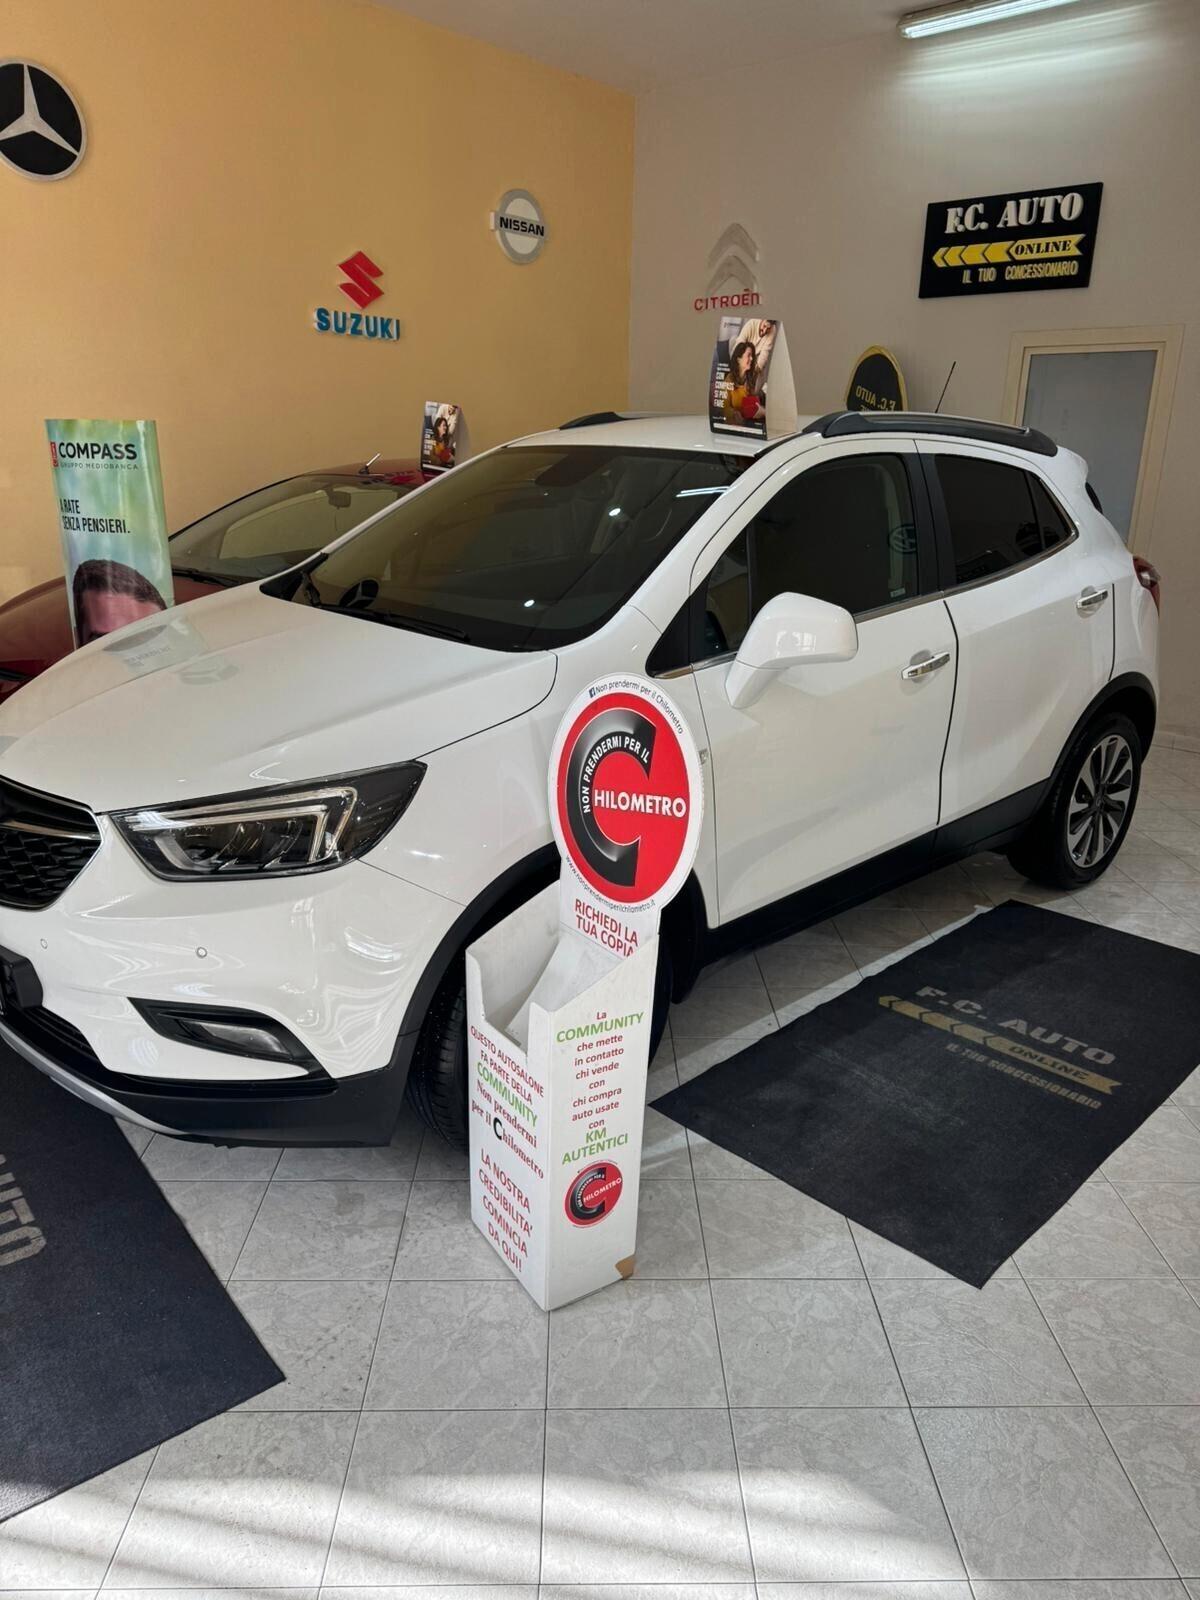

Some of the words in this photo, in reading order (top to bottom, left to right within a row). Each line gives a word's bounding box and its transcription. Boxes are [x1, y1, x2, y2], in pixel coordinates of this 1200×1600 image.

[500, 216, 544, 236] NISSAN
[945, 203, 989, 234] F.C.
[997, 192, 1084, 228] AUTO
[1015, 240, 1072, 255] ONLINE
[962, 270, 972, 284] IL
[978, 268, 997, 282] TUO
[1005, 261, 1078, 281] CONCESSIONARIO
[314, 307, 400, 341] SUZUKI
[59, 442, 137, 460] COMPASS
[63, 499, 80, 514] RATE
[82, 518, 131, 534] PENSIERI.
[594, 683, 608, 693] Non
[608, 680, 640, 690] prendermi
[640, 686, 651, 696] per
[656, 695, 683, 734] Chilometro
[583, 735, 622, 783] PRENDERMI
[624, 736, 641, 755] PER
[641, 748, 650, 764] IL
[582, 786, 591, 814] NON
[575, 898, 622, 937] RICHIEDI
[625, 926, 638, 947] LA
[576, 914, 598, 939] TUA
[556, 1012, 644, 1043] COMMUNITY
[596, 1011, 607, 1020] La
[577, 1041, 593, 1052] che
[596, 1034, 623, 1047] mette
[998, 1018, 1116, 1065] AUTO
[470, 1025, 496, 1054] QUESTO
[497, 1049, 544, 1098] AUTOSALONE
[574, 1057, 583, 1067] in
[585, 1048, 624, 1064] contatto
[575, 1069, 589, 1080] chi
[591, 1061, 619, 1075] vende
[1008, 1045, 1091, 1080] ONLINE
[480, 1050, 489, 1065] FA
[490, 1057, 510, 1085] PARTE
[511, 1076, 533, 1105] DELLA
[588, 1078, 605, 1089] con
[961, 1048, 985, 1063] TUO
[988, 1059, 1102, 1109] CONCESSIONARIO
[477, 1062, 538, 1128] COMMUNITY
[572, 1097, 586, 1108] chi
[588, 1087, 622, 1103] compra
[477, 1079, 492, 1104] Non
[494, 1100, 537, 1148] prendermi
[572, 1109, 592, 1122] auto
[596, 1101, 619, 1114] usate
[588, 1118, 605, 1129] con
[471, 1100, 483, 1118] per
[485, 1112, 491, 1126] il
[493, 1117, 544, 1179] Chilometro
[562, 1133, 628, 1165] AUTENTICI
[586, 1127, 607, 1144] KM
[481, 1148, 491, 1170] LA
[493, 1162, 531, 1213] NOSTRA
[483, 1195, 528, 1258] COMINCIA
[488, 1221, 500, 1246] DA
[501, 1240, 522, 1272] QUI!
